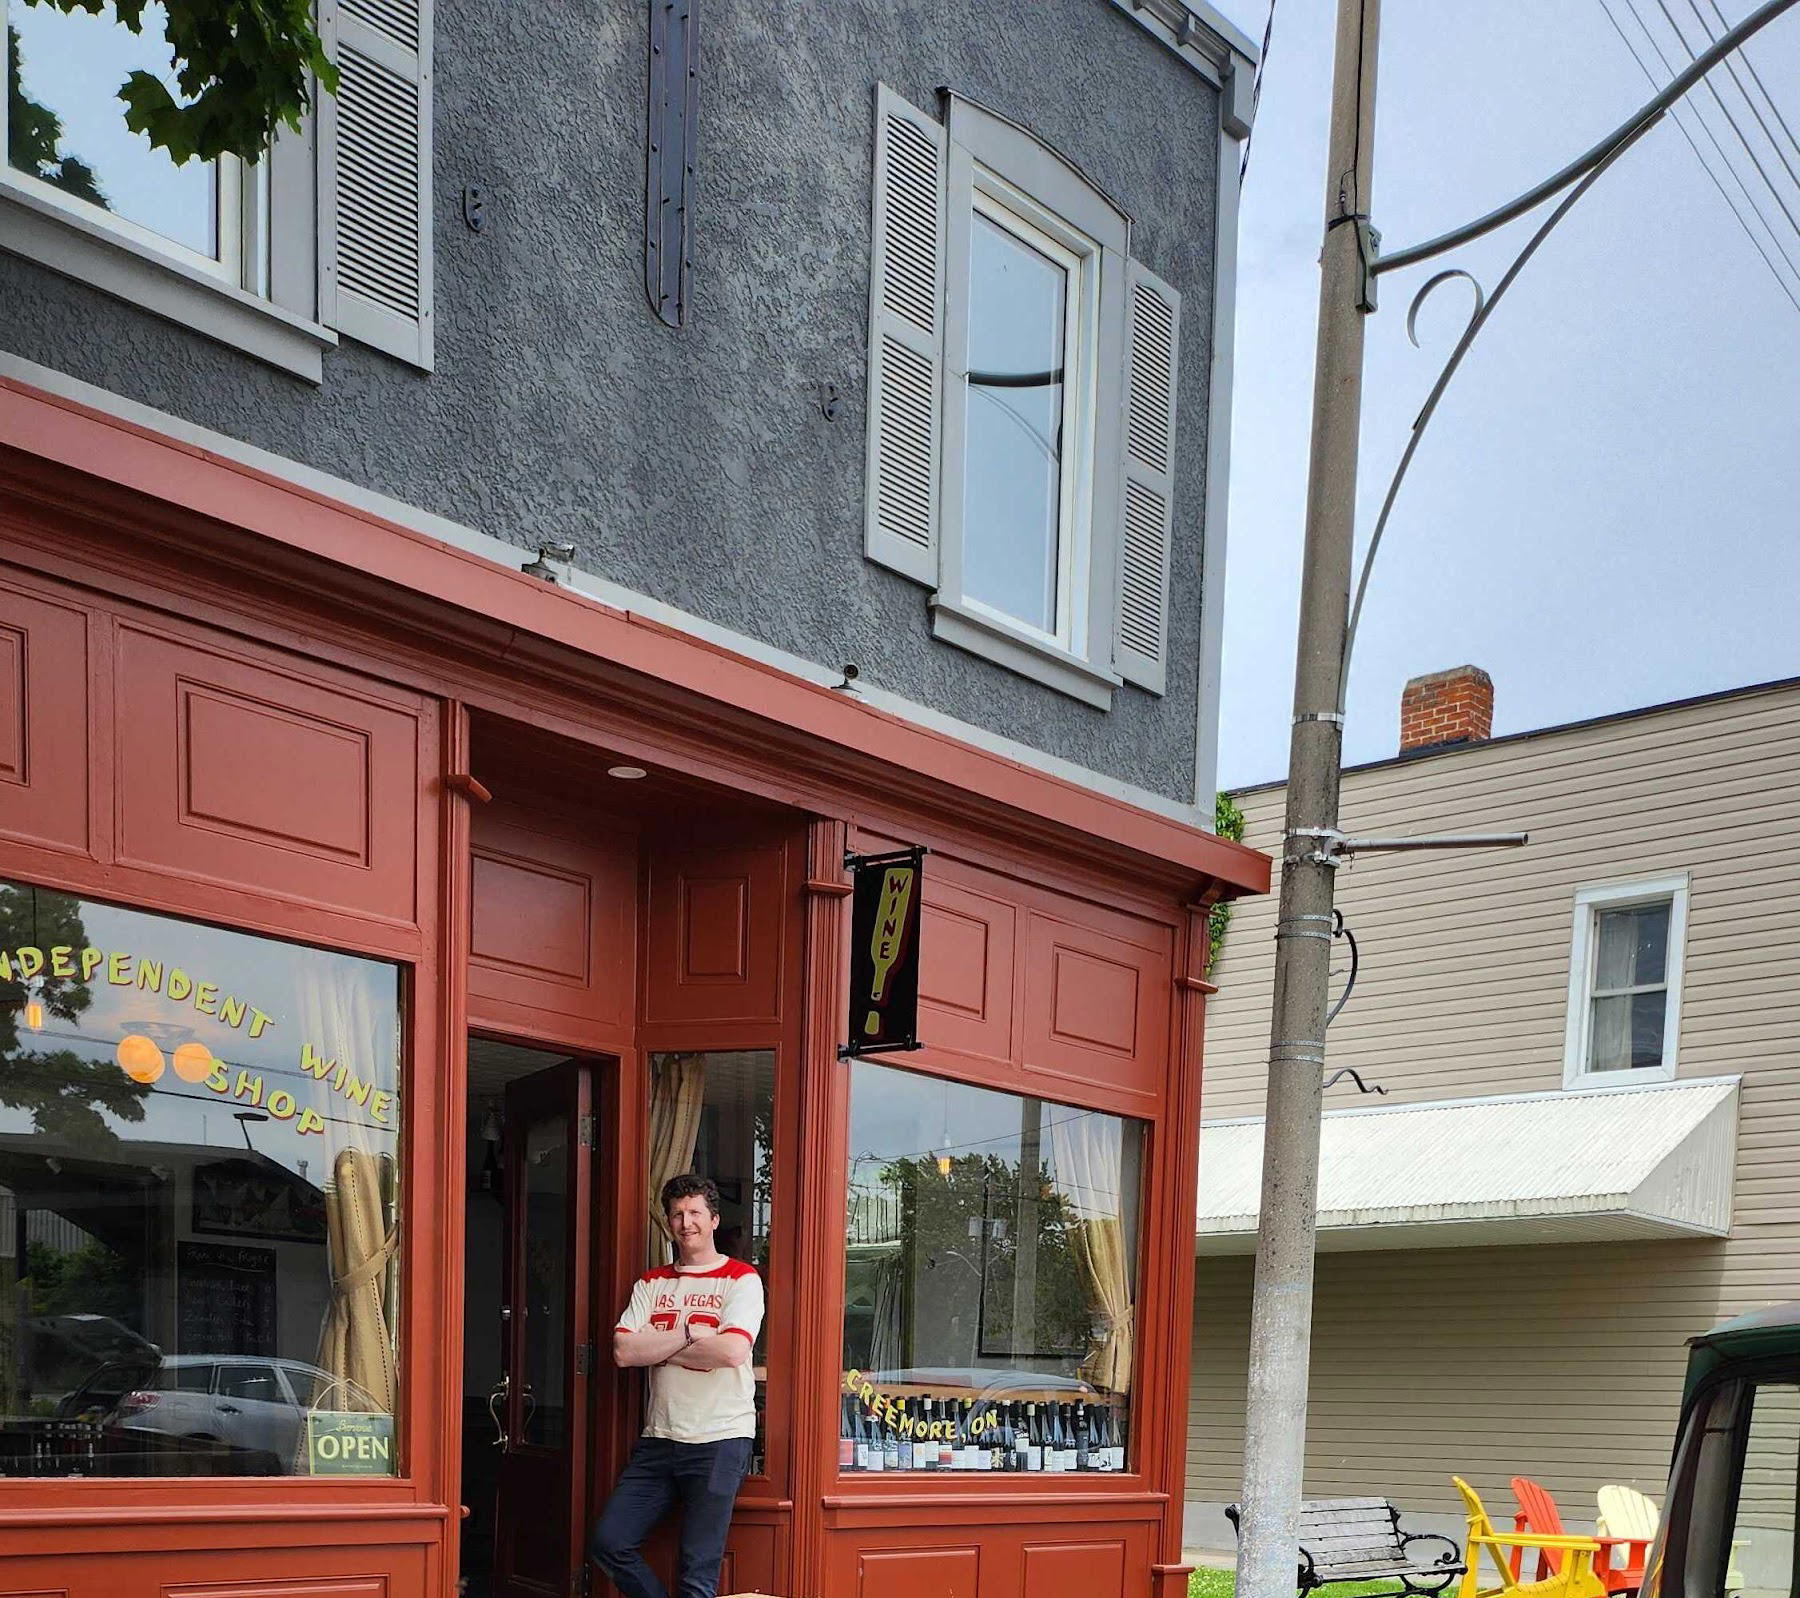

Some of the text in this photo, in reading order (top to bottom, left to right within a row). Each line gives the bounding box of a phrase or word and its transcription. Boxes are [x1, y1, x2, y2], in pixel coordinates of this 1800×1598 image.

[879, 875, 908, 959] WINE
[203, 1057, 326, 1135] SHOP
[300, 1042, 392, 1124] WINE
[684, 1293, 723, 1310] VEGAS
[317, 1435, 390, 1460] OPEN
[970, 1408, 998, 1436] ON
